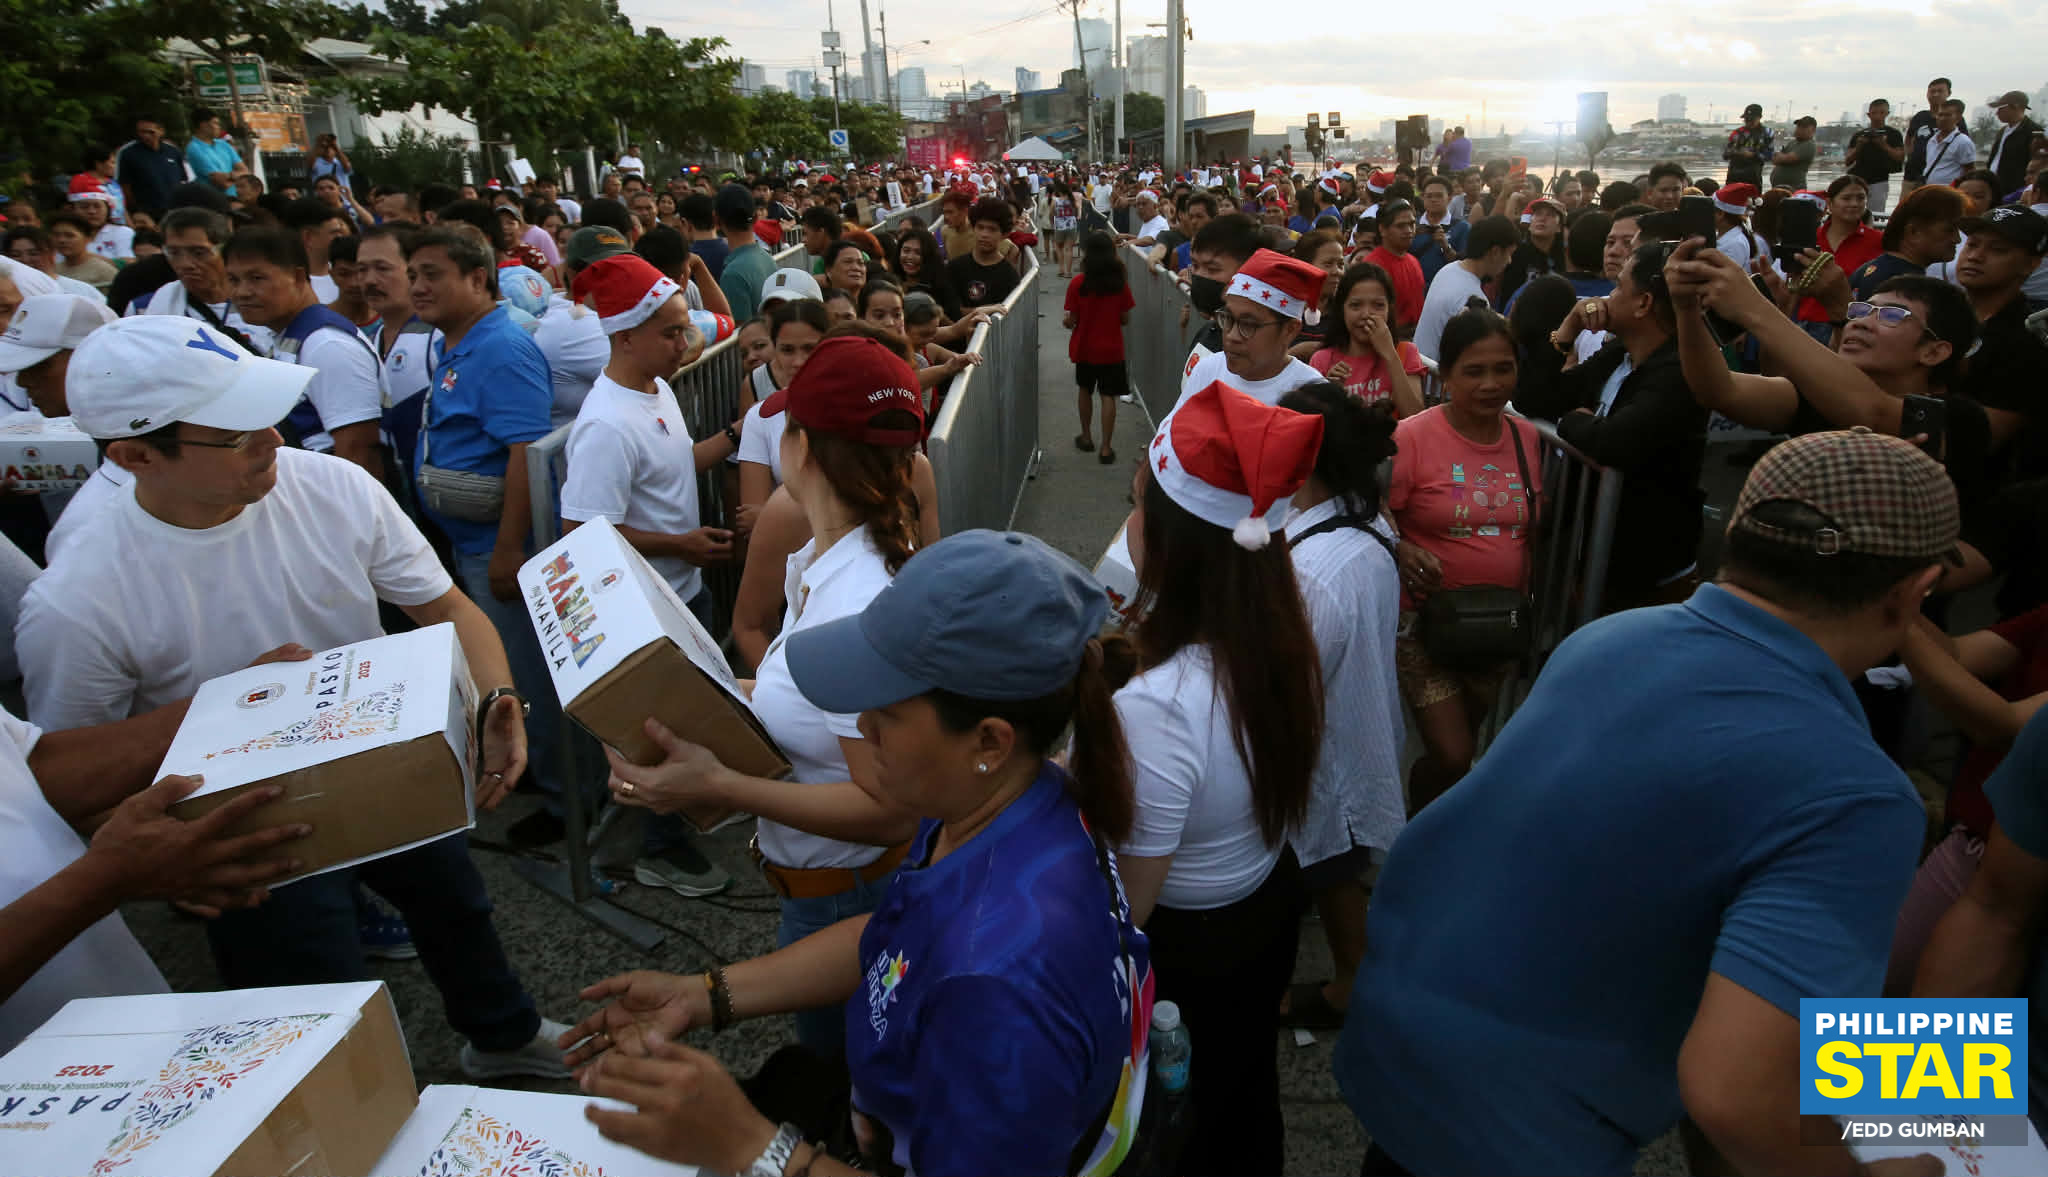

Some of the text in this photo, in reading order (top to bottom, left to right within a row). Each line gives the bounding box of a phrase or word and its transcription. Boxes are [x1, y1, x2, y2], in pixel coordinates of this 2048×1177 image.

[187, 327, 240, 361] Y
[867, 388, 895, 404] NEW
[0, 464, 89, 481] ANILA
[541, 550, 607, 670] MANILA
[533, 595, 569, 672] MANILA
[315, 652, 344, 709] PASKO
[357, 660, 372, 680] 2025
[55, 1064, 115, 1077] 2025
